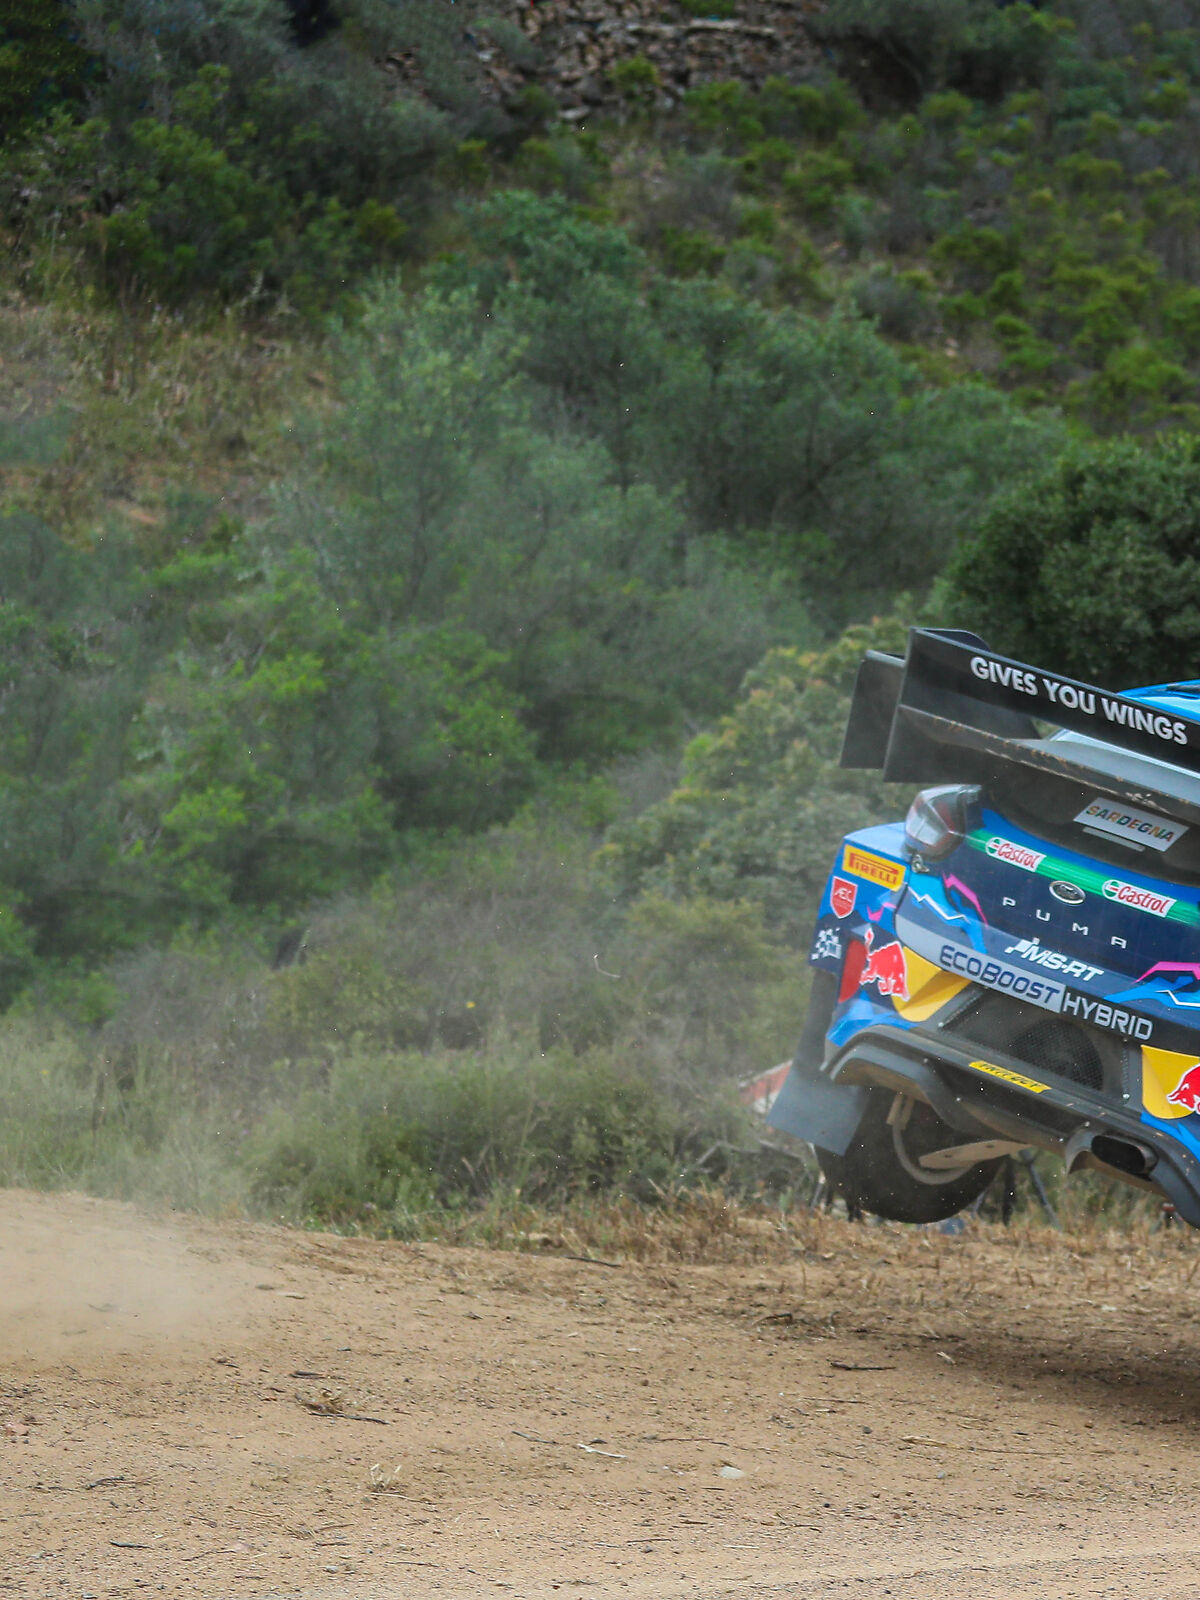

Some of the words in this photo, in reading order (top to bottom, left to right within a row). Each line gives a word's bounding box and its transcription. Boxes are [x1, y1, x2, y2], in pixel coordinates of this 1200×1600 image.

[970, 656, 1038, 696] GIVES
[1042, 677, 1096, 715] YOU
[1101, 697, 1188, 745] WINGS
[1086, 805, 1175, 842] SARDEGNA
[849, 852, 899, 885] PIRELLI
[997, 841, 1040, 869] Castrol
[1115, 885, 1170, 914] Castrol
[1003, 896, 1127, 949] PUMA
[939, 945, 1060, 1003] ECOBOOST
[1063, 992, 1153, 1040] HYBRID
